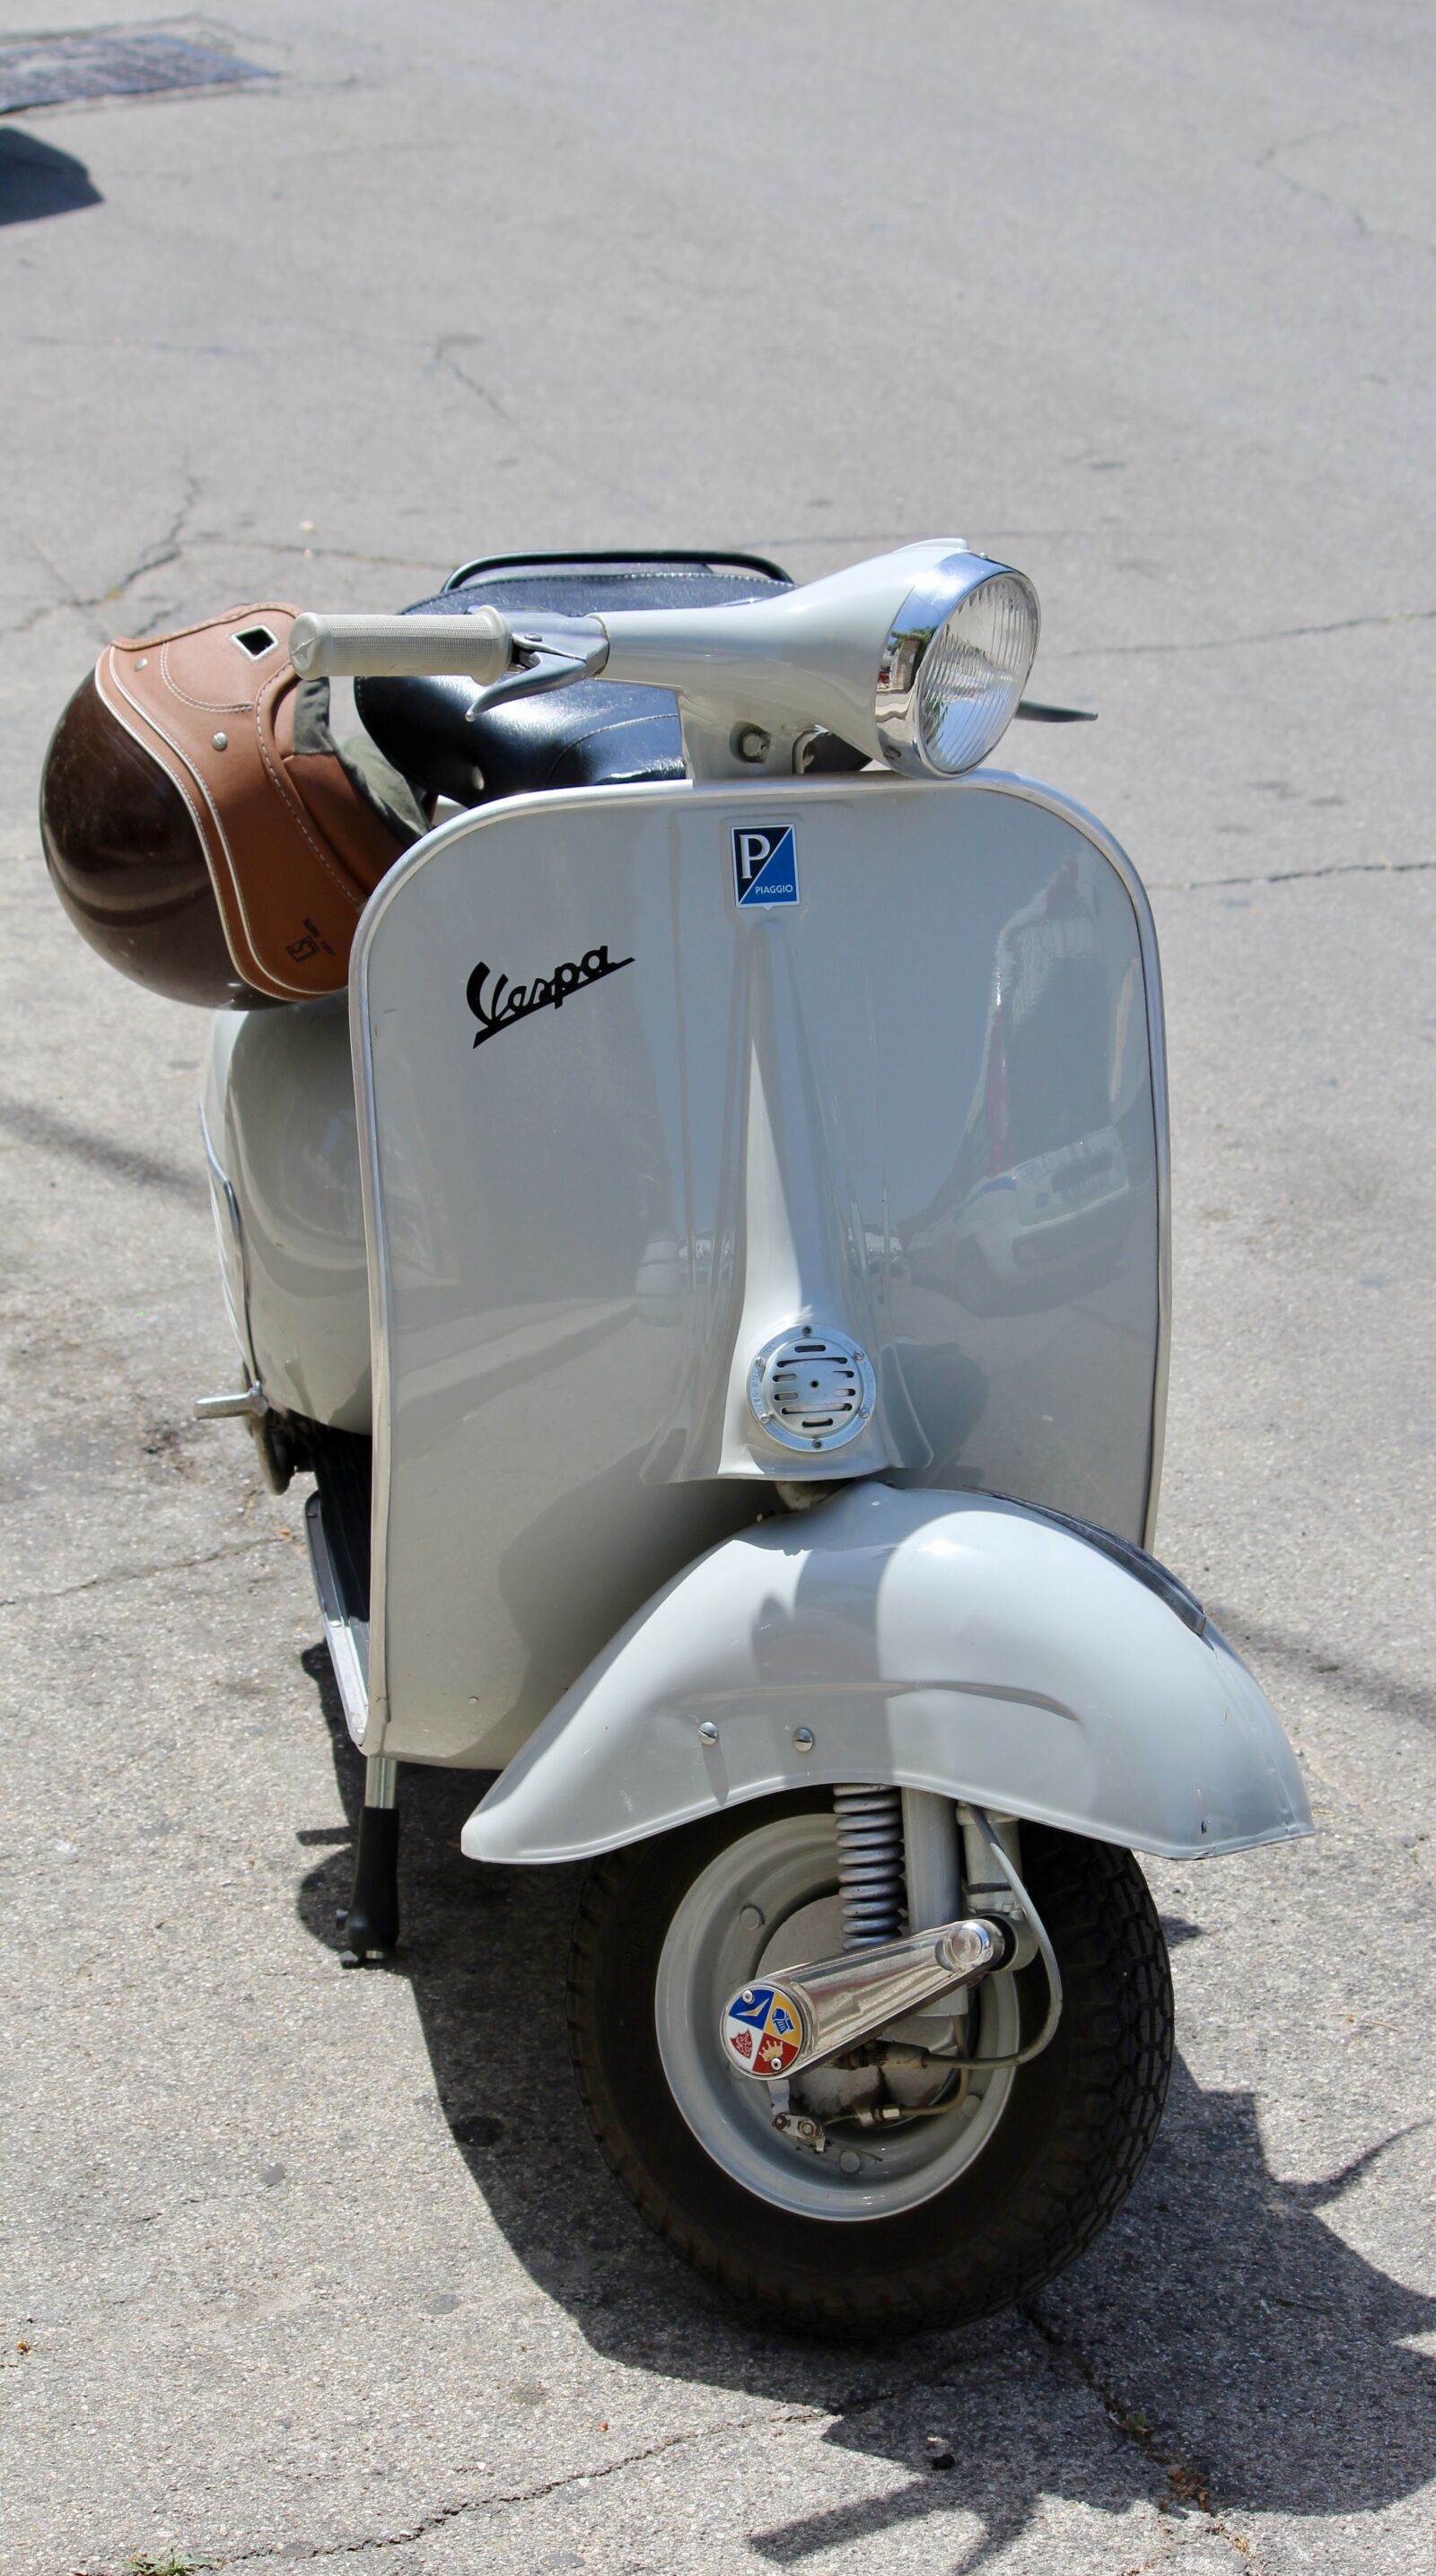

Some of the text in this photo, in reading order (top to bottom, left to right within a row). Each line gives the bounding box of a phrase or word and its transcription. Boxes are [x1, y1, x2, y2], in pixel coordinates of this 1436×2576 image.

[739, 834, 771, 879] P
[755, 884, 793, 895] PIAGGIO
[466, 945, 636, 1049] Vespa
